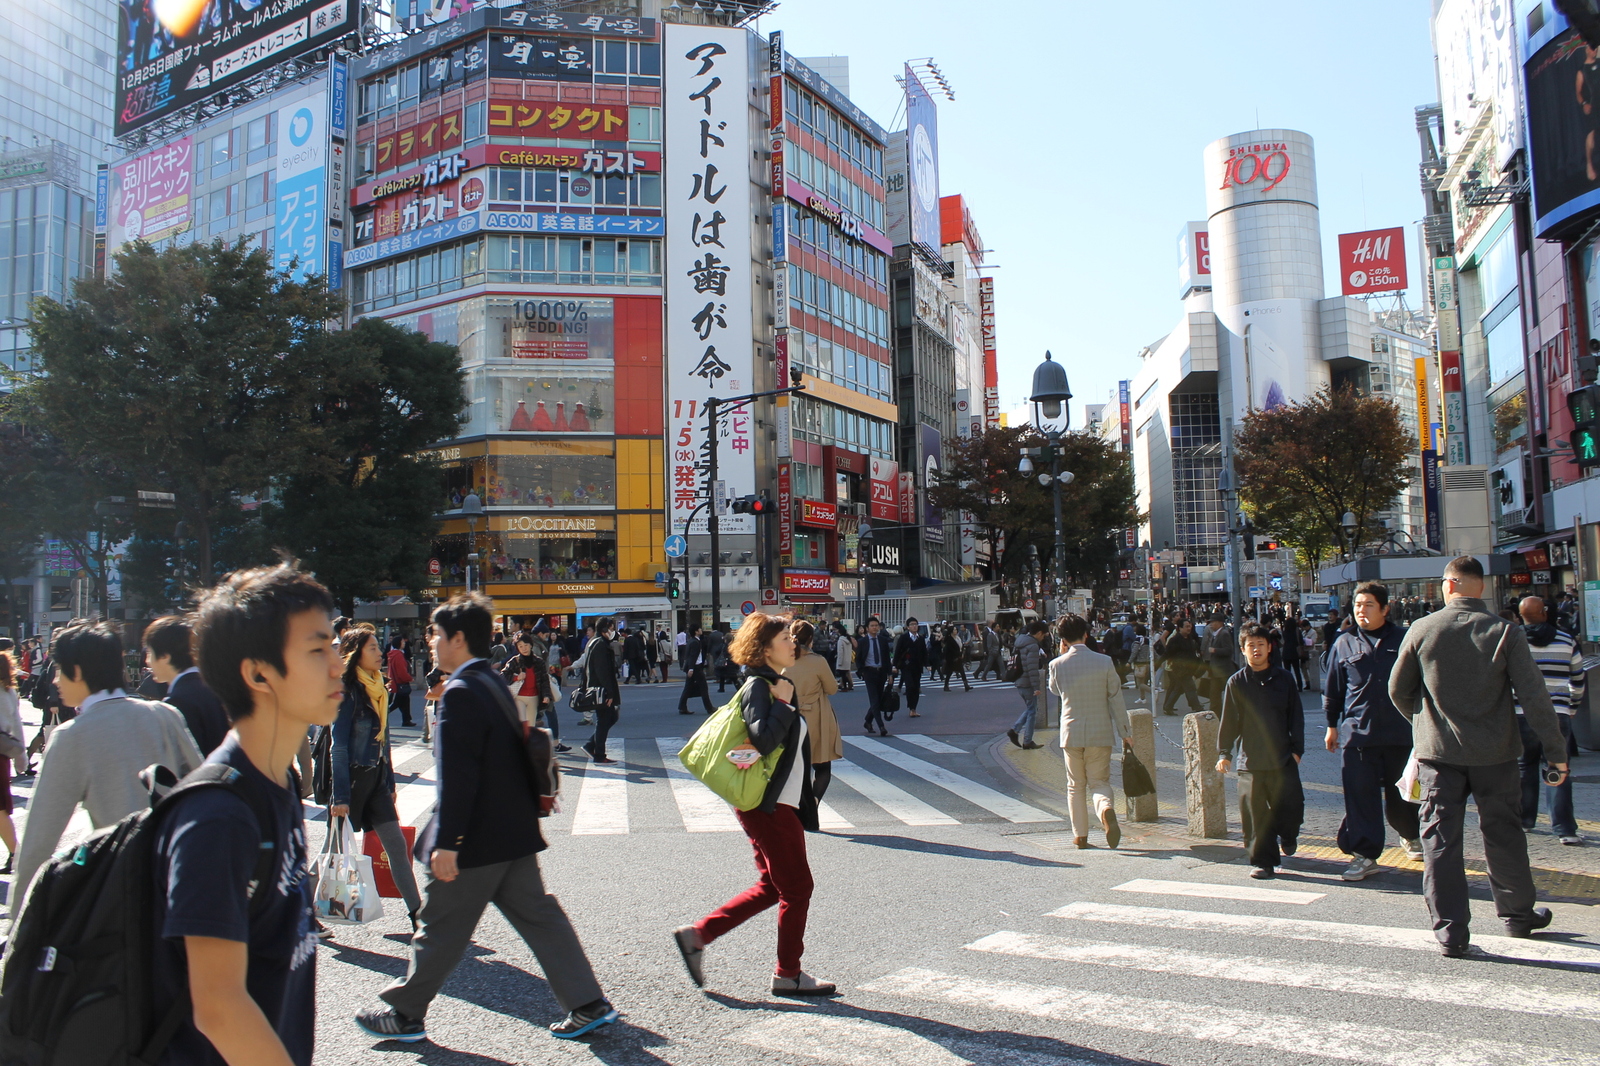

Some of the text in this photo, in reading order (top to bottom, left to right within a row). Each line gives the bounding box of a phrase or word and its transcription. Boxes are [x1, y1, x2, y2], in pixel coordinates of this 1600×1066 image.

[215, 4, 342, 77] スターダストレコーズ 検索
[490, 105, 624, 132] コンタクト
[378, 115, 460, 164] プライス
[1230, 143, 1288, 157] SHIBUYA
[123, 145, 190, 190] 品川スキン
[282, 146, 318, 170] eyecity
[583, 150, 645, 174] ガスト
[424, 154, 466, 188] ガスト
[774, 163, 782, 192] ガスト
[887, 173, 904, 193] 地
[1220, 151, 1290, 192] 109
[123, 169, 189, 214] クリニック
[333, 162, 342, 210] 献血ルーム
[464, 190, 482, 203] ガスト
[402, 193, 453, 234] ガスト
[487, 214, 660, 232] AEON 英会話イーオン
[685, 42, 731, 389] アイドルは歯が命
[356, 218, 374, 239] 7F
[346, 218, 473, 265] AEON 英会話イーオン 6F
[1352, 235, 1391, 264] H&M
[1368, 267, 1390, 275] この先
[1369, 275, 1400, 286] 150m
[513, 301, 588, 321] 1000%
[776, 335, 786, 343] 5F
[1444, 367, 1458, 376] JTB
[732, 400, 750, 454] エビ中
[873, 482, 893, 500] アコム
[508, 516, 596, 531] L'OCCITANE
[816, 510, 835, 520] サンドラッグ
[872, 544, 899, 566] LUSH
[800, 578, 824, 588] サンドラッグ
